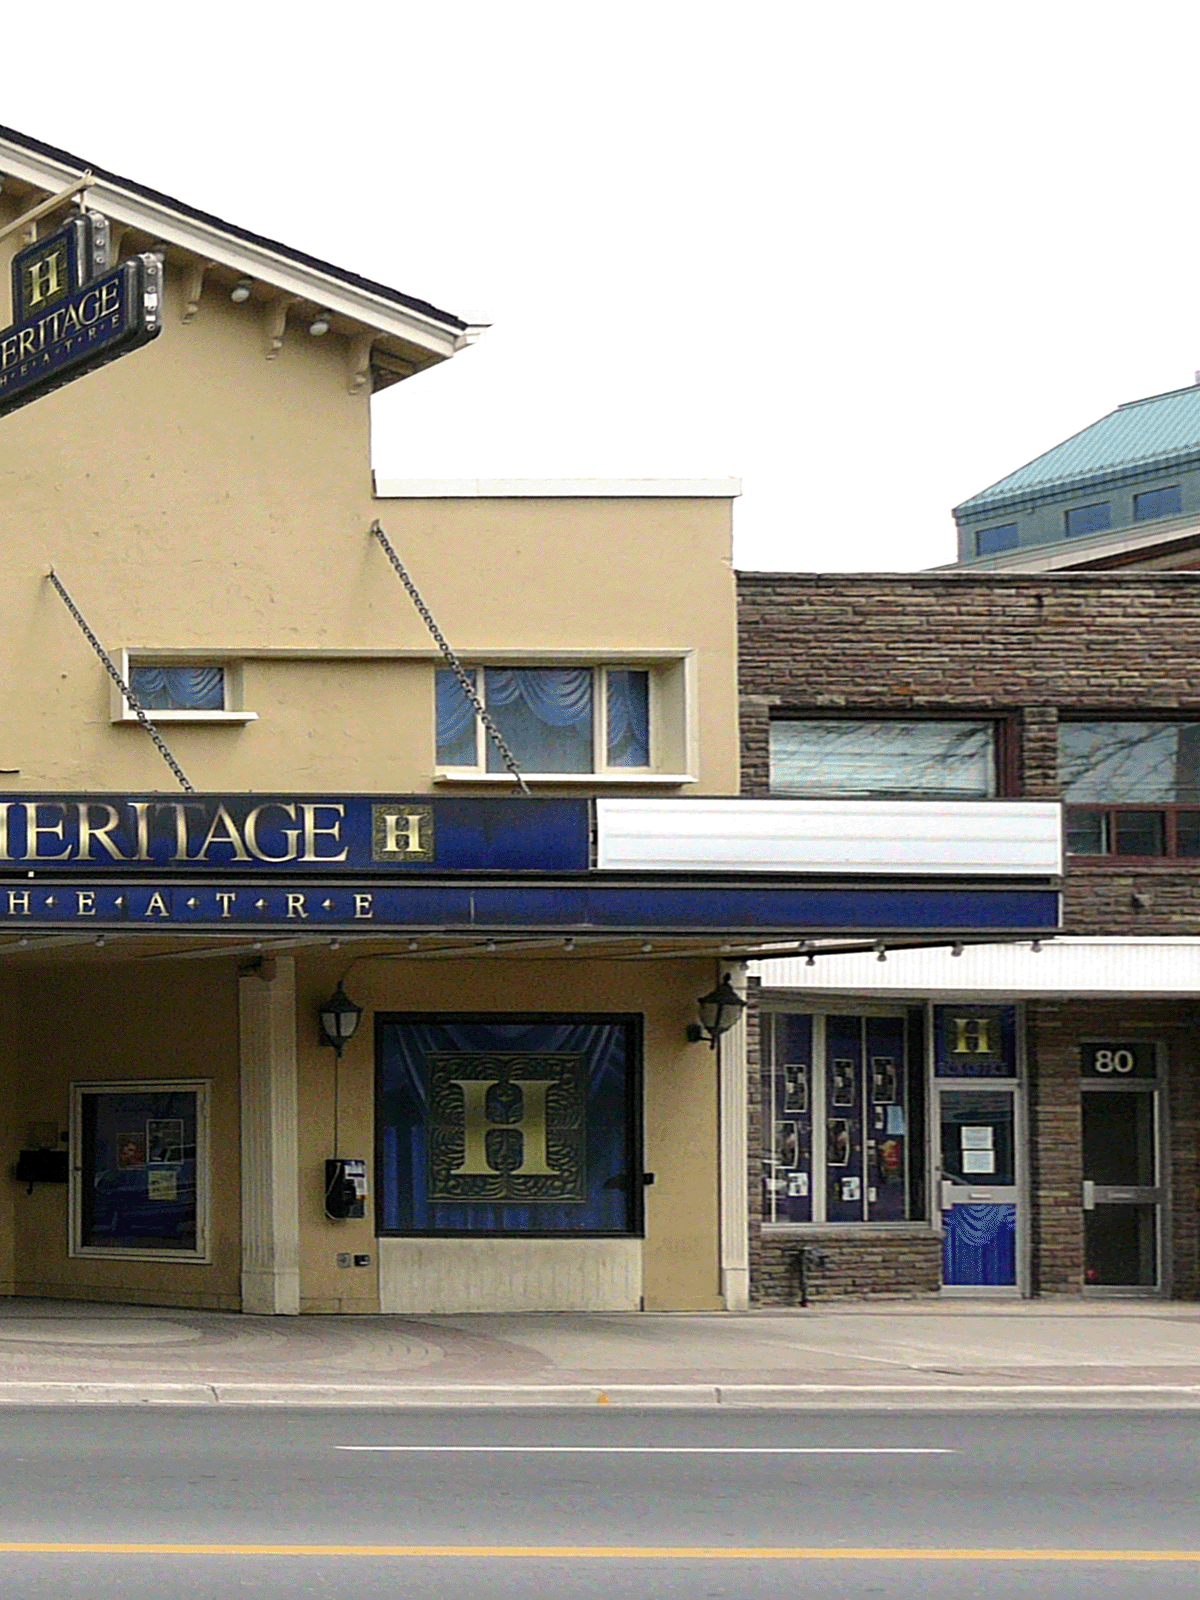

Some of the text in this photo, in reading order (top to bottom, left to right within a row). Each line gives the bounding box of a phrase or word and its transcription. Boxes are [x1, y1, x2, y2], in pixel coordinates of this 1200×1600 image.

[28, 251, 62, 307] H
[382, 814, 428, 852] H
[950, 1018, 996, 1054] H
[1095, 1049, 1134, 1073] 80
[449, 1080, 561, 1176] H
